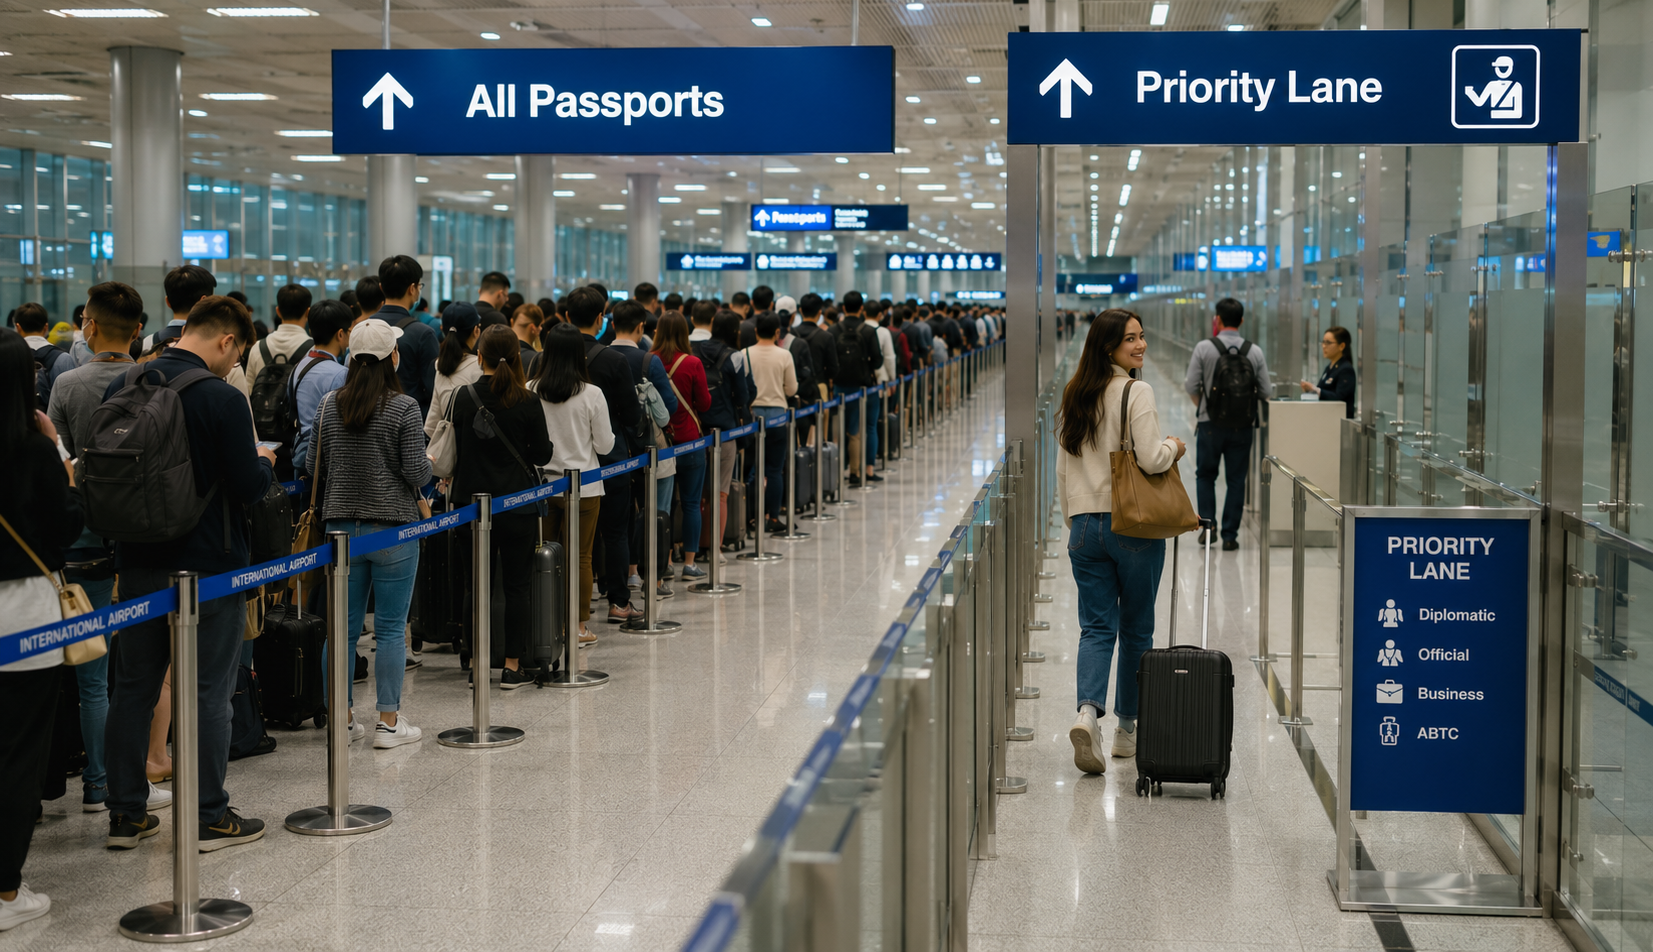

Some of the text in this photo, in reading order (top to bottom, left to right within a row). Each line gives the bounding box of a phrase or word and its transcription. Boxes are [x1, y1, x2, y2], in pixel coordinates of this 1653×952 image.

[1137, 70, 1383, 112] Priority Lane
[466, 84, 725, 126] All Passports
[1387, 536, 1495, 556] PRIORITY
[231, 552, 318, 588] INTERNATIONAL AIRPORT
[1409, 561, 1471, 581] LANE
[1418, 607, 1496, 624] Diplomatic
[20, 600, 151, 653] INTERNATIONAL AIRPORT
[1418, 647, 1470, 662] Official
[1418, 687, 1485, 701] Business
[1417, 727, 1459, 740] ABTC
